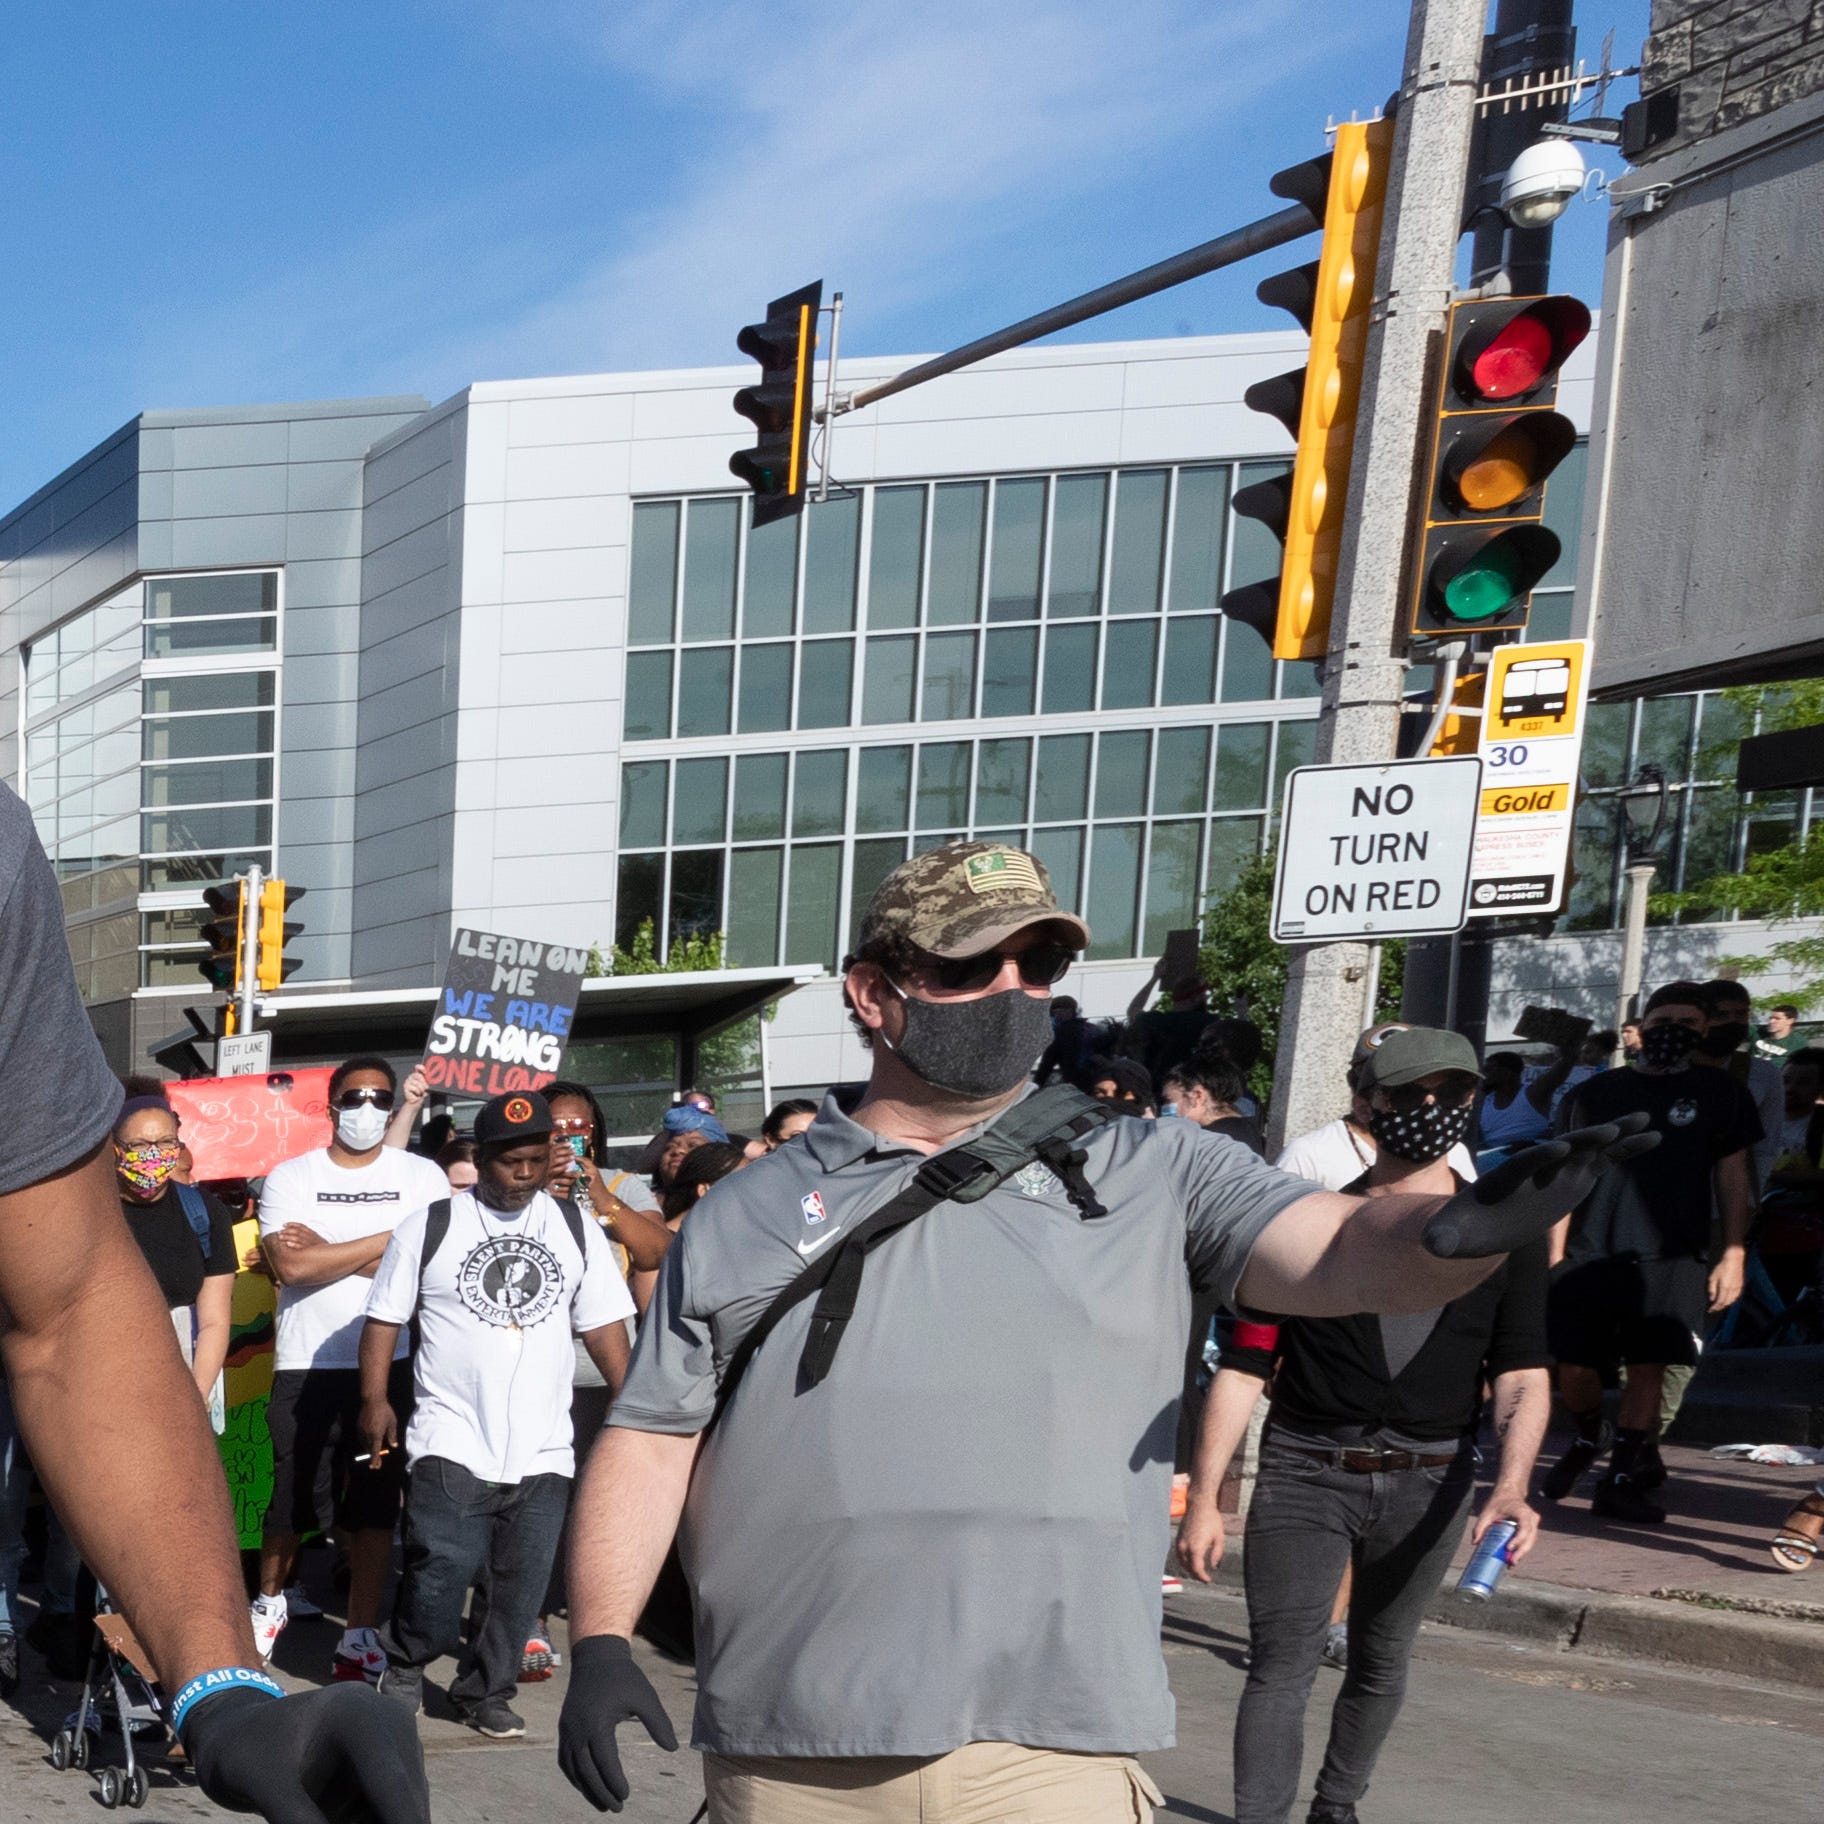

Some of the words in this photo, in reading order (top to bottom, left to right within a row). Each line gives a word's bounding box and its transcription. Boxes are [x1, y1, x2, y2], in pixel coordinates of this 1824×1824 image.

[1520, 721, 1544, 731] 4337
[1488, 745, 1528, 767] 30
[1351, 783, 1414, 818] NO
[1493, 790, 1555, 813] Gold
[1329, 831, 1429, 866] TURN
[1305, 883, 1356, 916] ON
[1366, 879, 1441, 912] RED
[458, 931, 543, 967] LEAN
[546, 947, 588, 975] ON
[491, 964, 539, 996] ME
[445, 988, 495, 1020] WE
[505, 999, 573, 1036] ARE
[223, 1043, 241, 1058] LEFT
[244, 1040, 264, 1055] LANE
[431, 1015, 561, 1072] STRONG
[231, 1062, 255, 1075] MUST
[425, 1055, 485, 1093] ONE
[466, 1242, 505, 1281] SILENT
[510, 1241, 559, 1282] PARTNA
[206, 1669, 233, 1687] All
[235, 1669, 280, 1691] Odds
